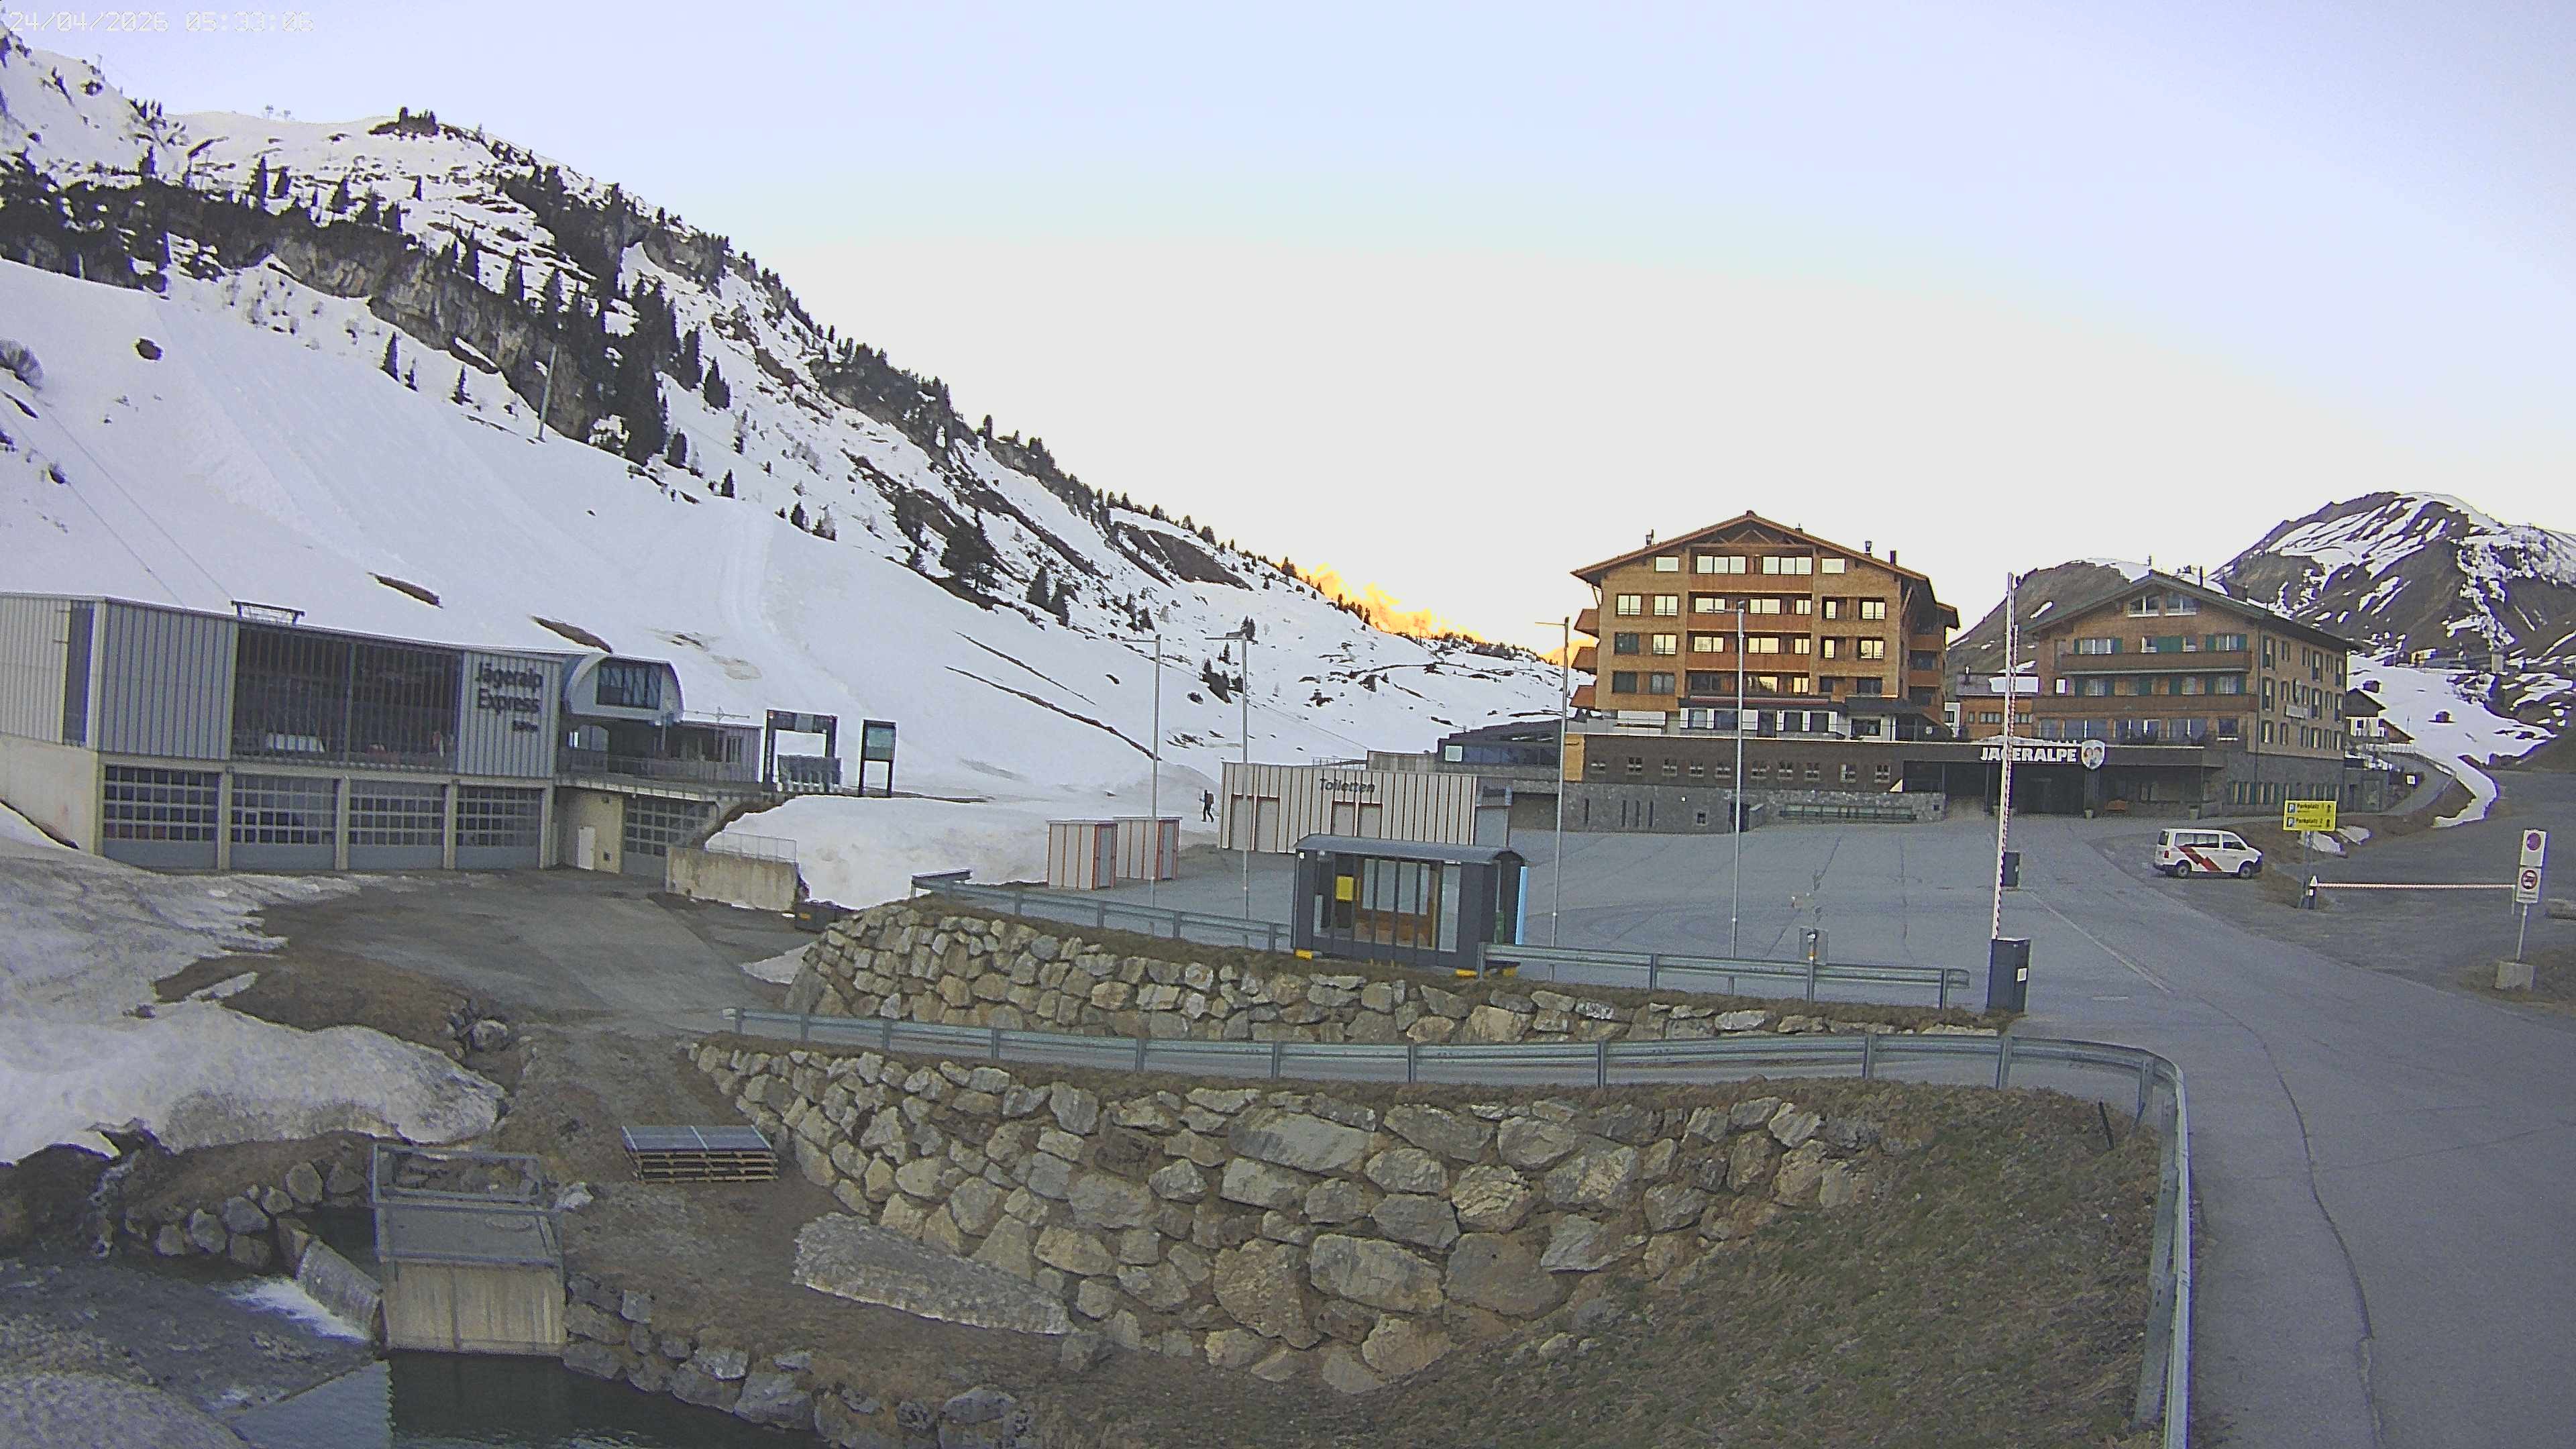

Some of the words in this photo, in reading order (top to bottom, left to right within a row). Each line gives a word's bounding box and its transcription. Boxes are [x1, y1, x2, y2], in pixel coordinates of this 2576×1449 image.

[475, 661, 543, 693] Jägeralp
[478, 688, 540, 714] Express
[1320, 777, 1375, 792] Toiletten
